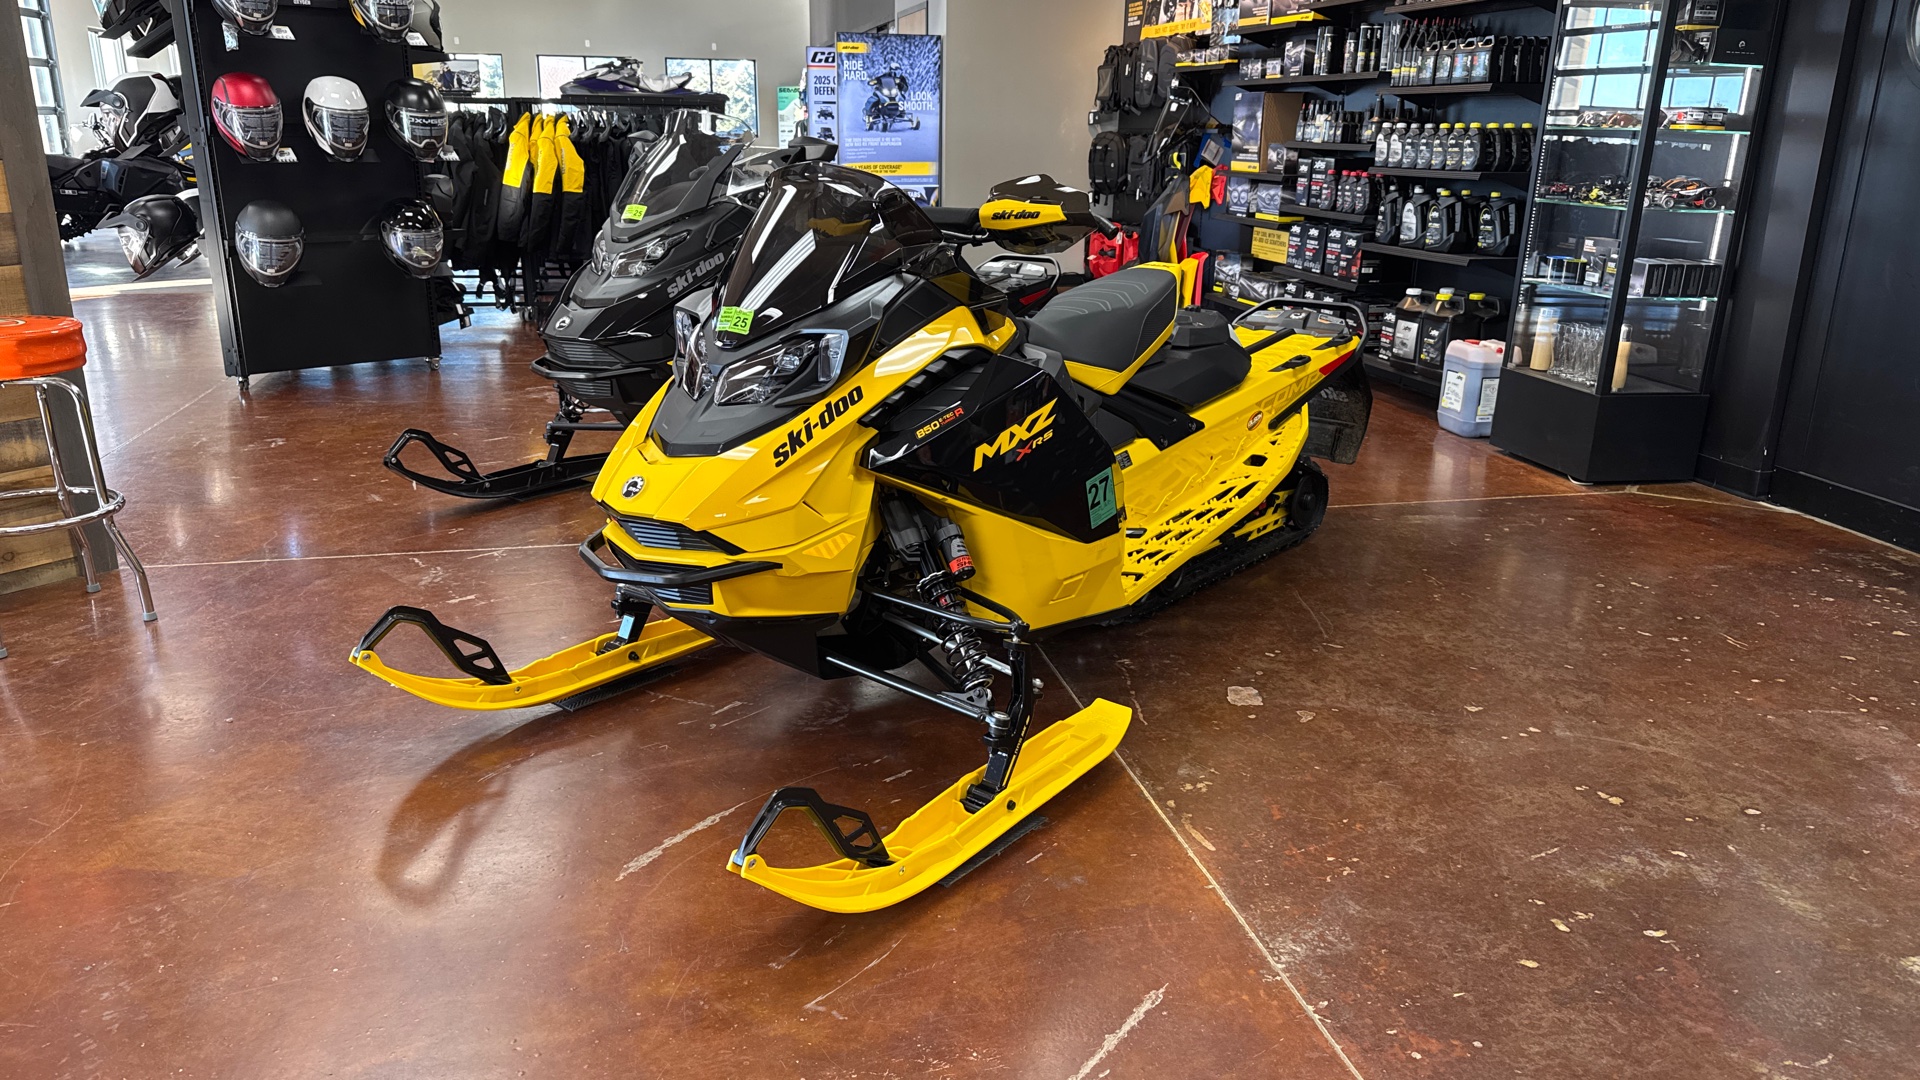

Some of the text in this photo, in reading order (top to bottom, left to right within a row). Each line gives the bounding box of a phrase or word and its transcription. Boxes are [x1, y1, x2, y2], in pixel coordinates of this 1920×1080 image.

[843, 61, 864, 71] RIDE
[814, 76, 831, 85] 2025
[843, 71, 870, 81] HARD.
[910, 92, 933, 101] LOOK
[898, 101, 935, 111] SMOOTH.
[991, 210, 1041, 220] ski-doo
[667, 252, 725, 299] ski-doo
[733, 316, 748, 329] 25
[954, 407, 965, 418] R
[773, 385, 864, 468] ski-doo
[916, 420, 940, 439] 850
[973, 397, 1058, 473] MXZ
[1088, 475, 1110, 511] 27
